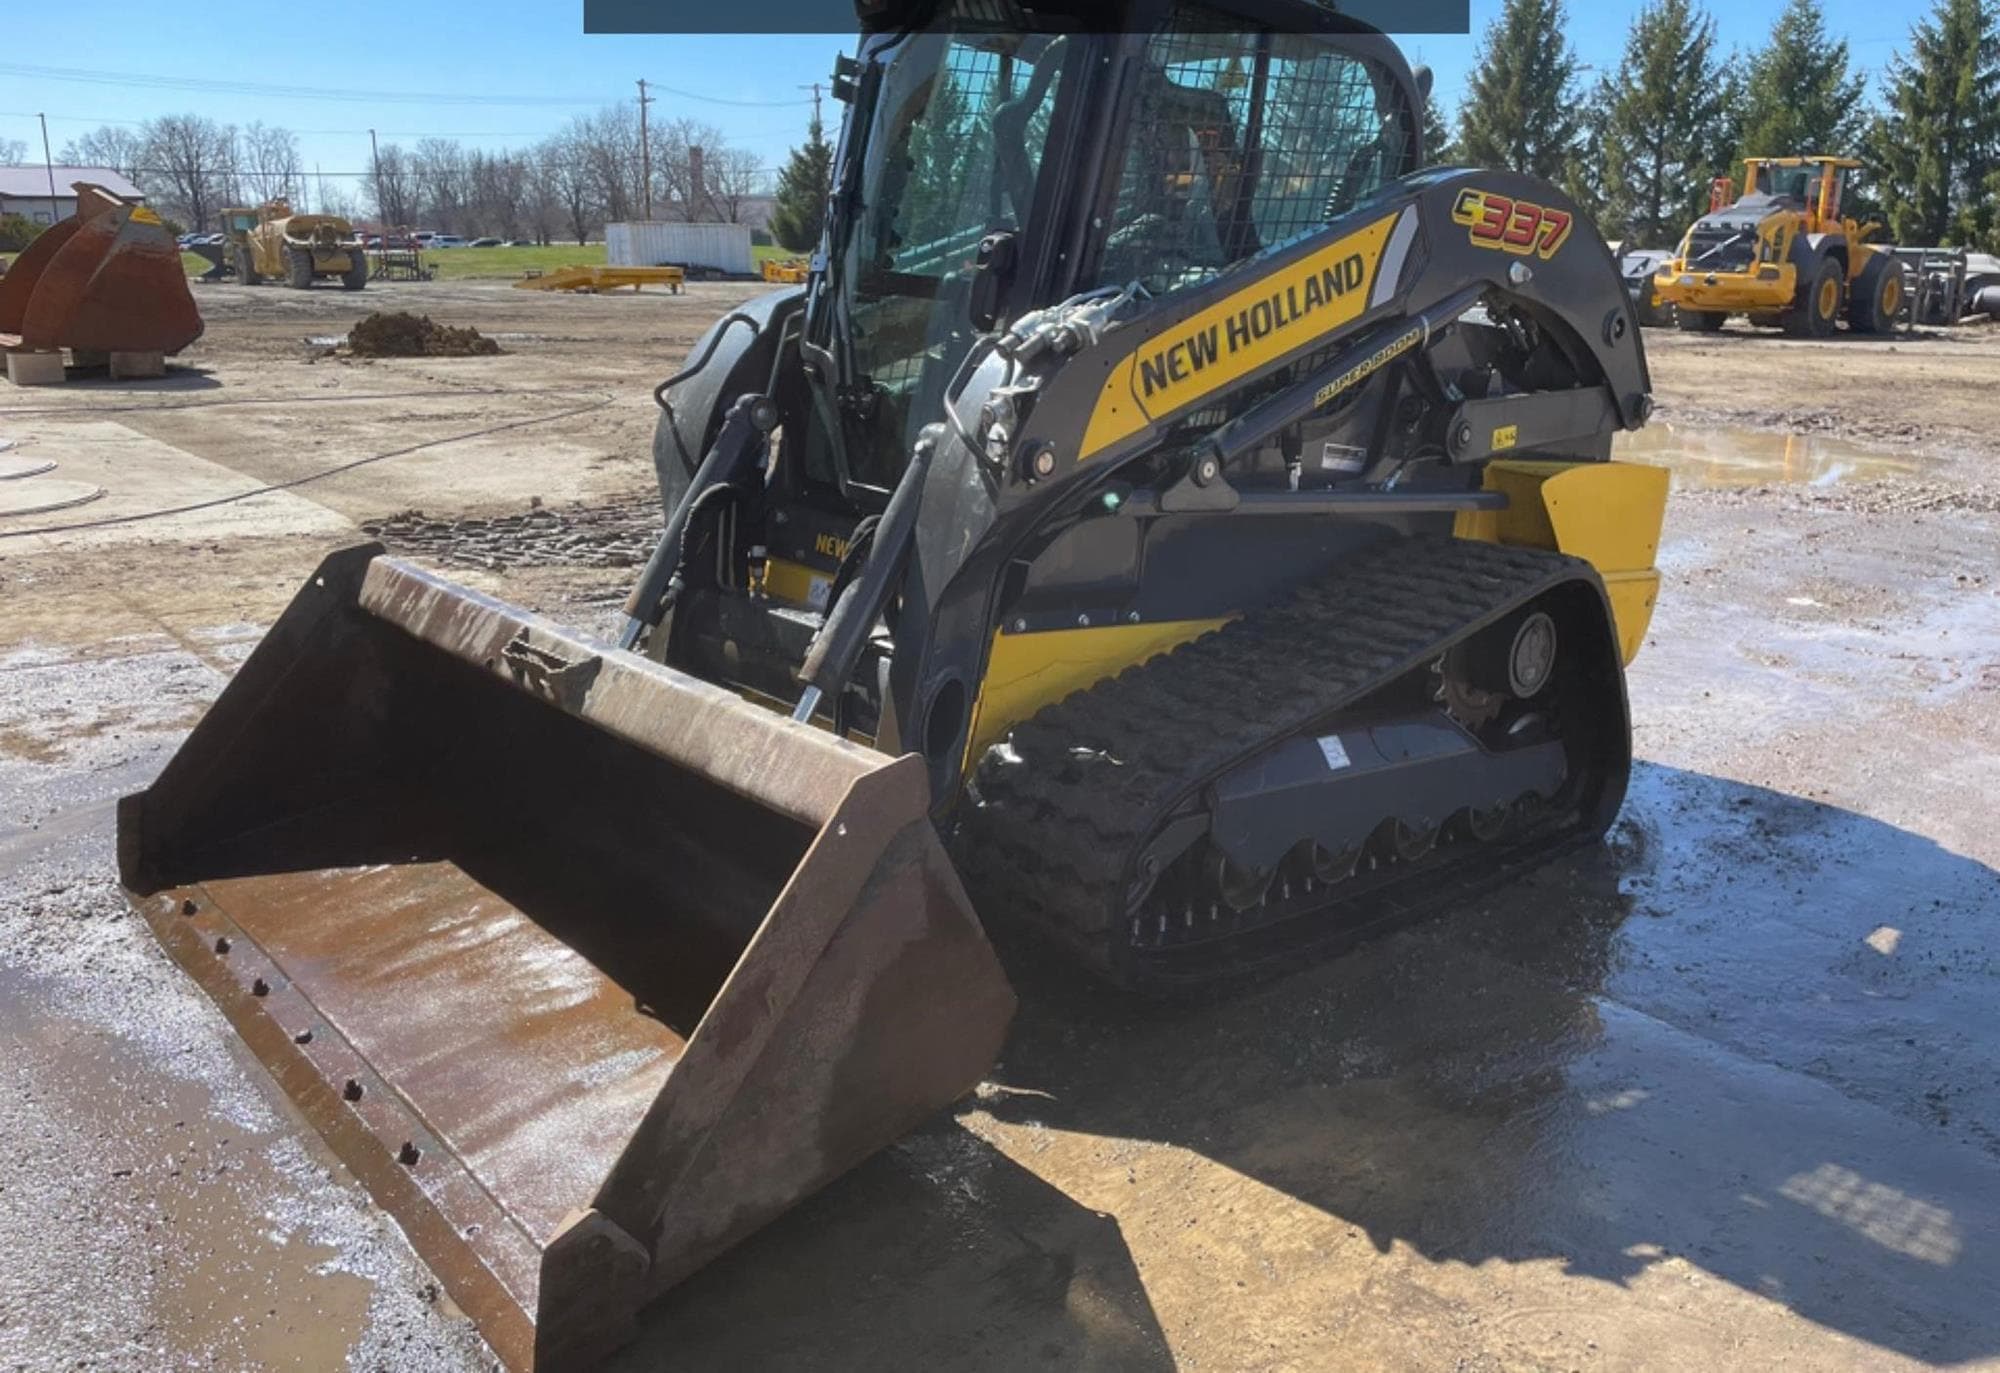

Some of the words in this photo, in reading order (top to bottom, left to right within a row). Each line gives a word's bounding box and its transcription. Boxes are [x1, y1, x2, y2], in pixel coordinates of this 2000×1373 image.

[1140, 324, 1219, 397] NEW
[1225, 252, 1365, 353] HOLLAND
[815, 532, 850, 558] NEW
